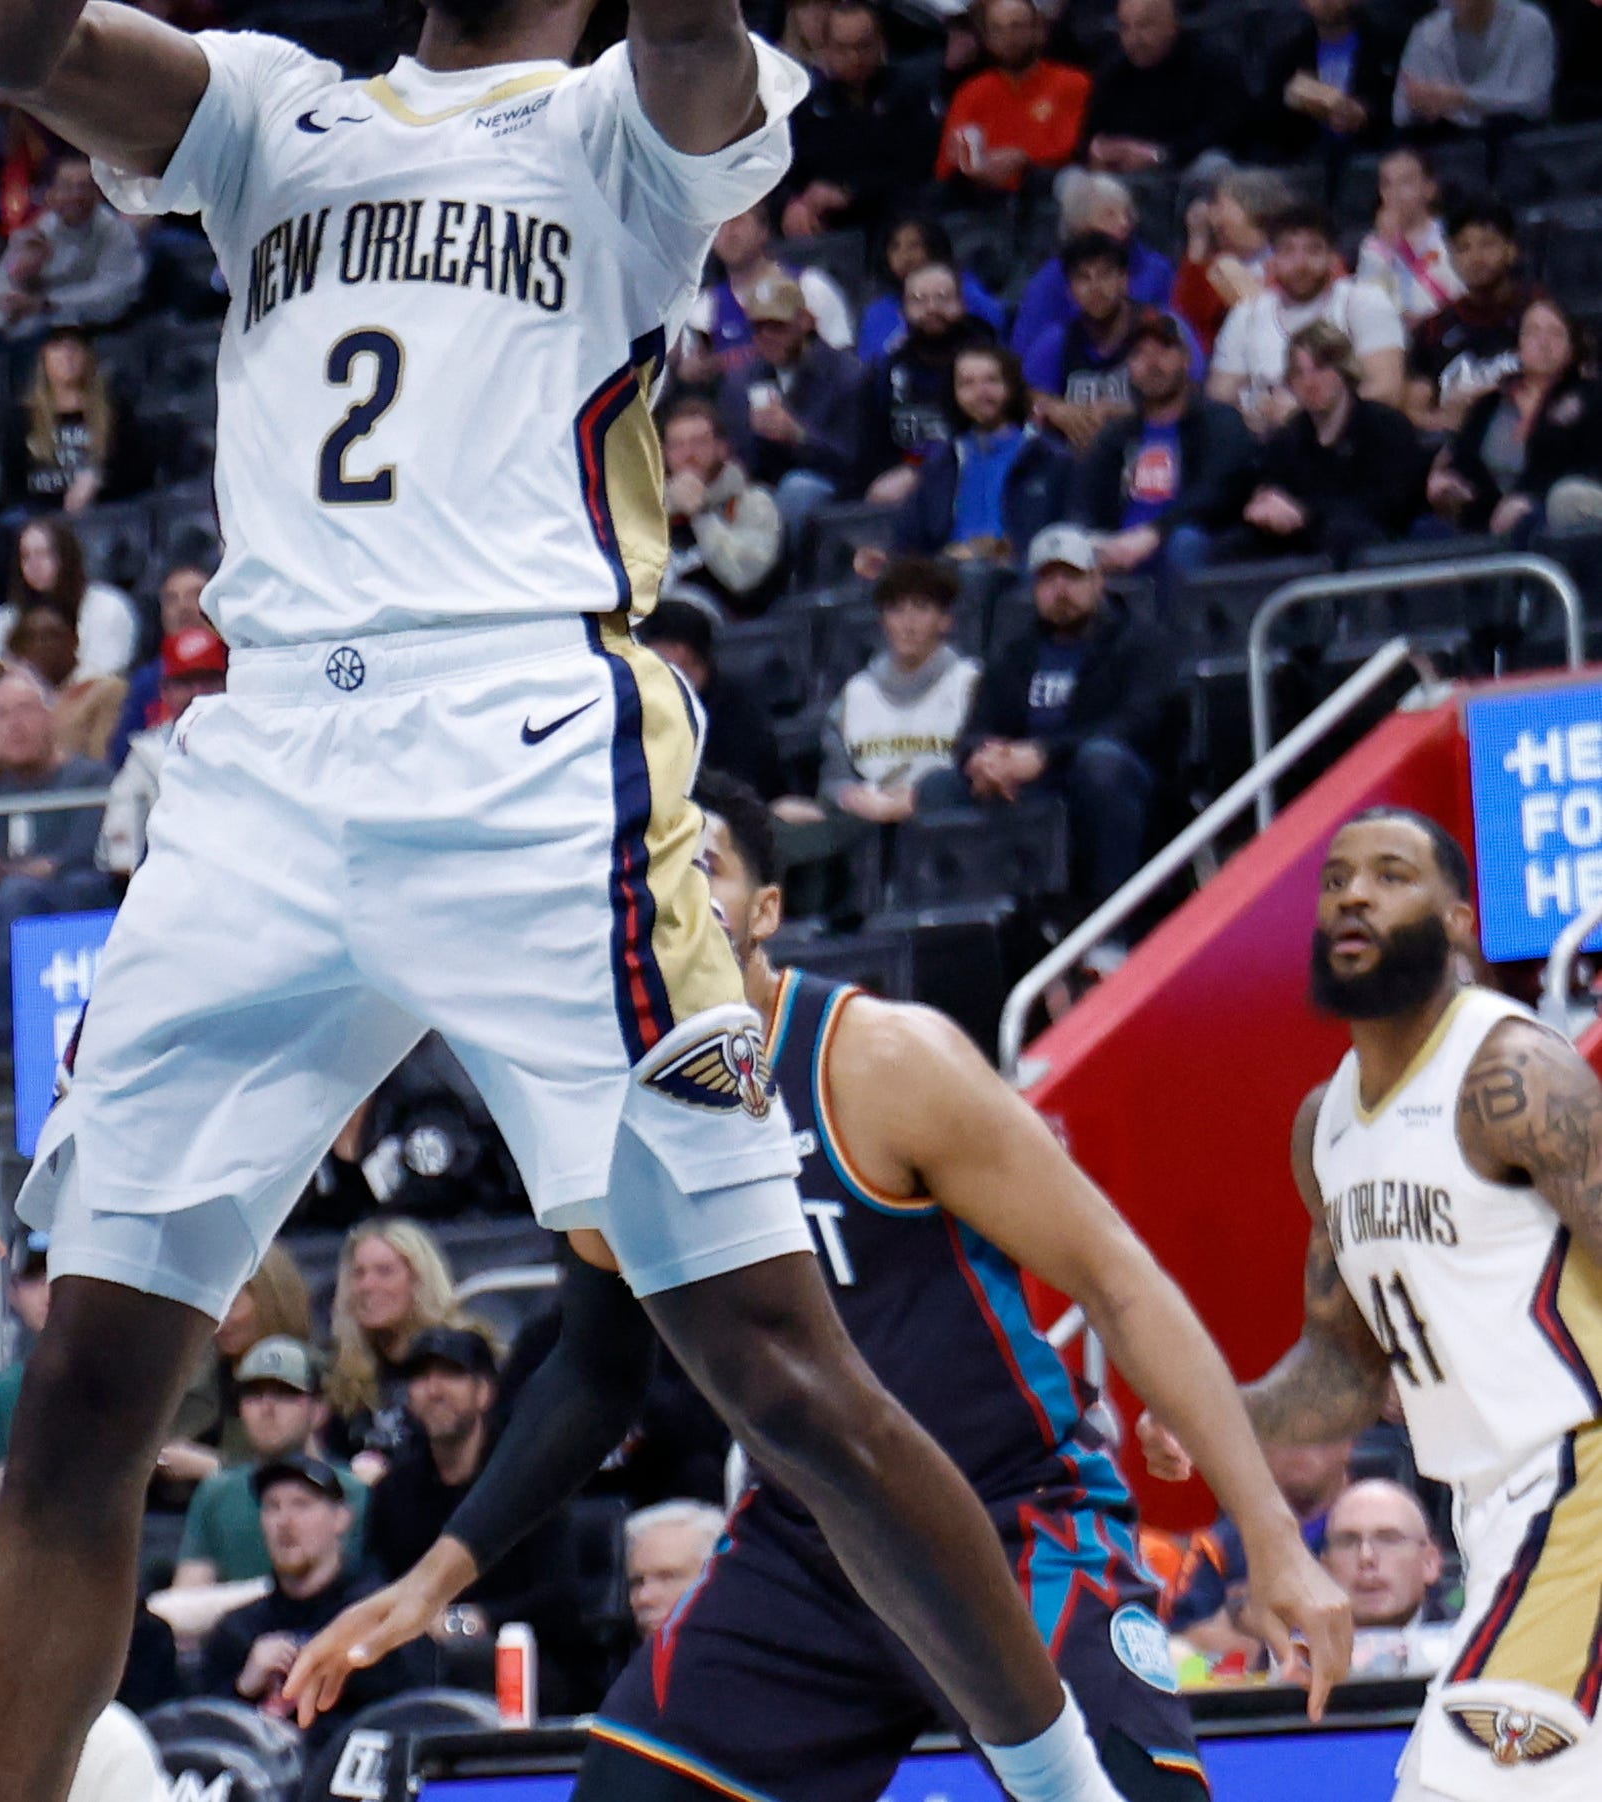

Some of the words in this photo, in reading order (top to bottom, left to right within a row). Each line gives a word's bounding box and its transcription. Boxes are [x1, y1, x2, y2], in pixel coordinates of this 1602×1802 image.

[243, 205, 332, 335] NEW
[339, 199, 571, 313] ORLEANS
[313, 324, 406, 508] 2
[1348, 1180, 1458, 1248] ORLEANS
[1370, 1268, 1445, 1388] 41
